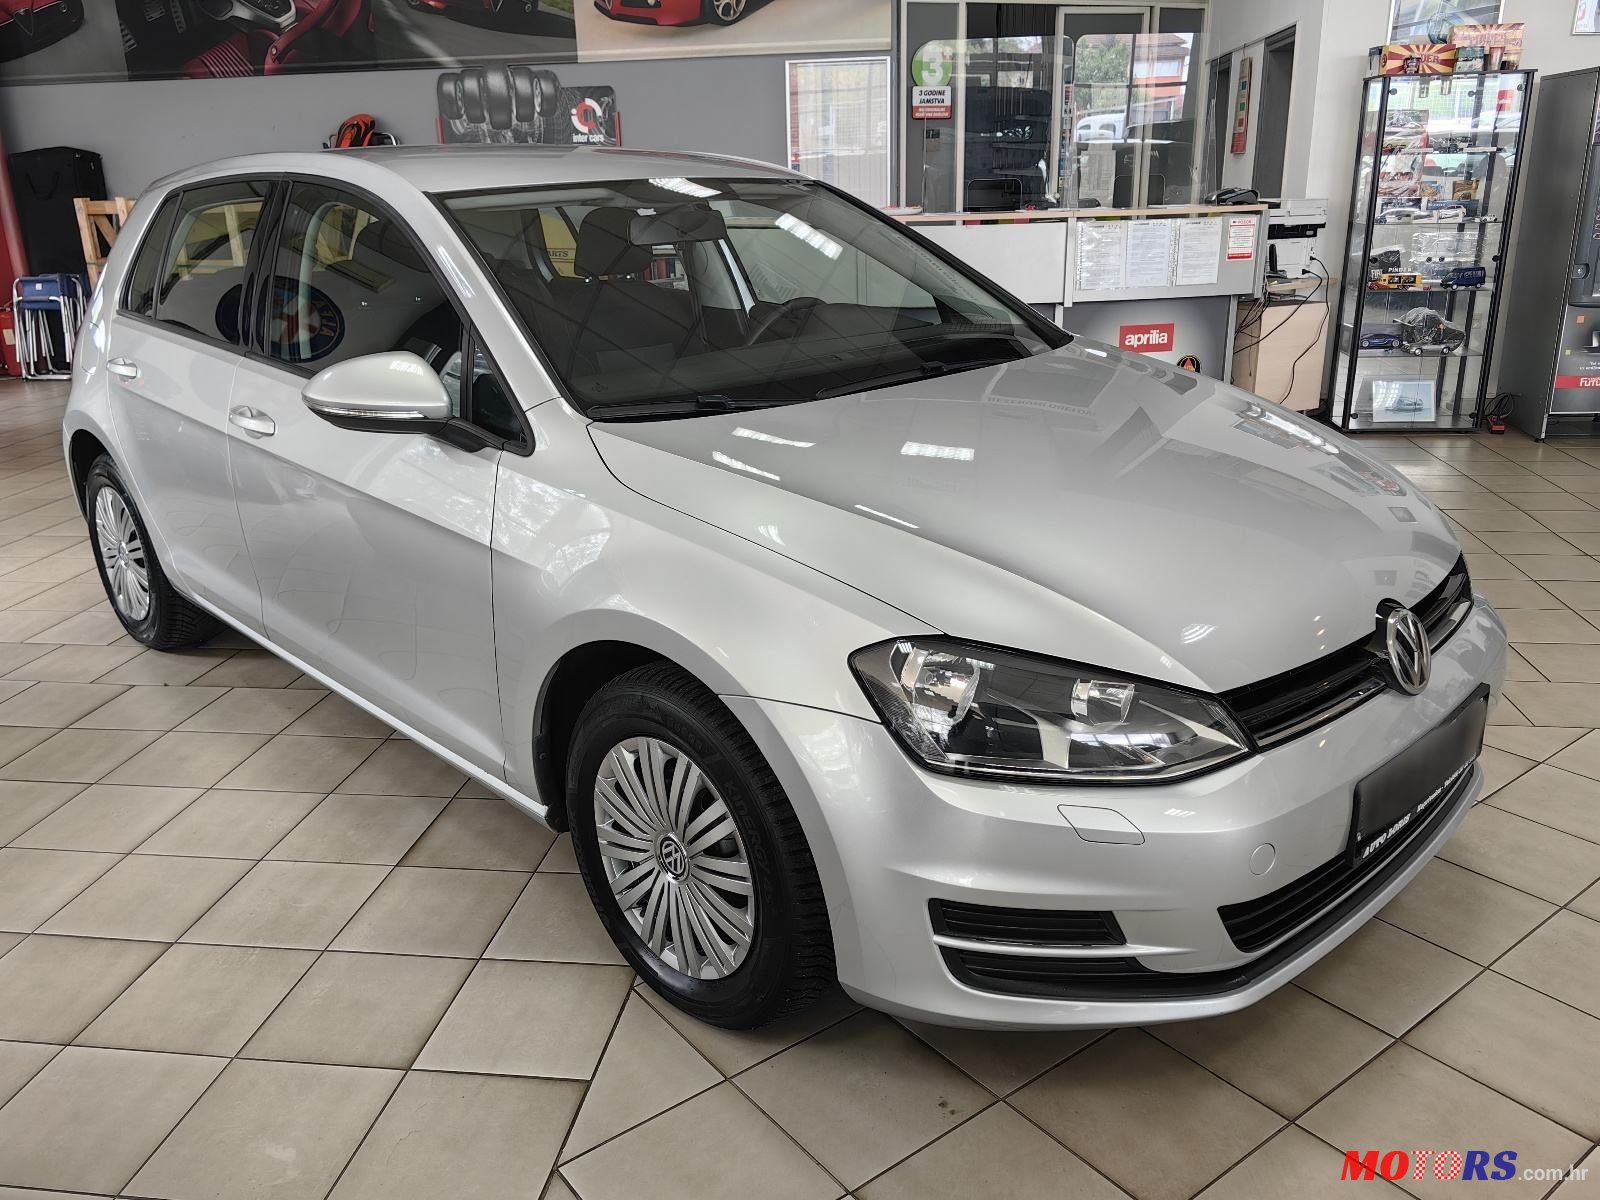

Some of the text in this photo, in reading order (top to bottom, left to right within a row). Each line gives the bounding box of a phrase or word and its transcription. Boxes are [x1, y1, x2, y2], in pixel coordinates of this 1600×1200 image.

[572, 133, 604, 143] inter cars
[1125, 329, 1168, 348] aprilia
[1363, 832, 1388, 858] AUTO
